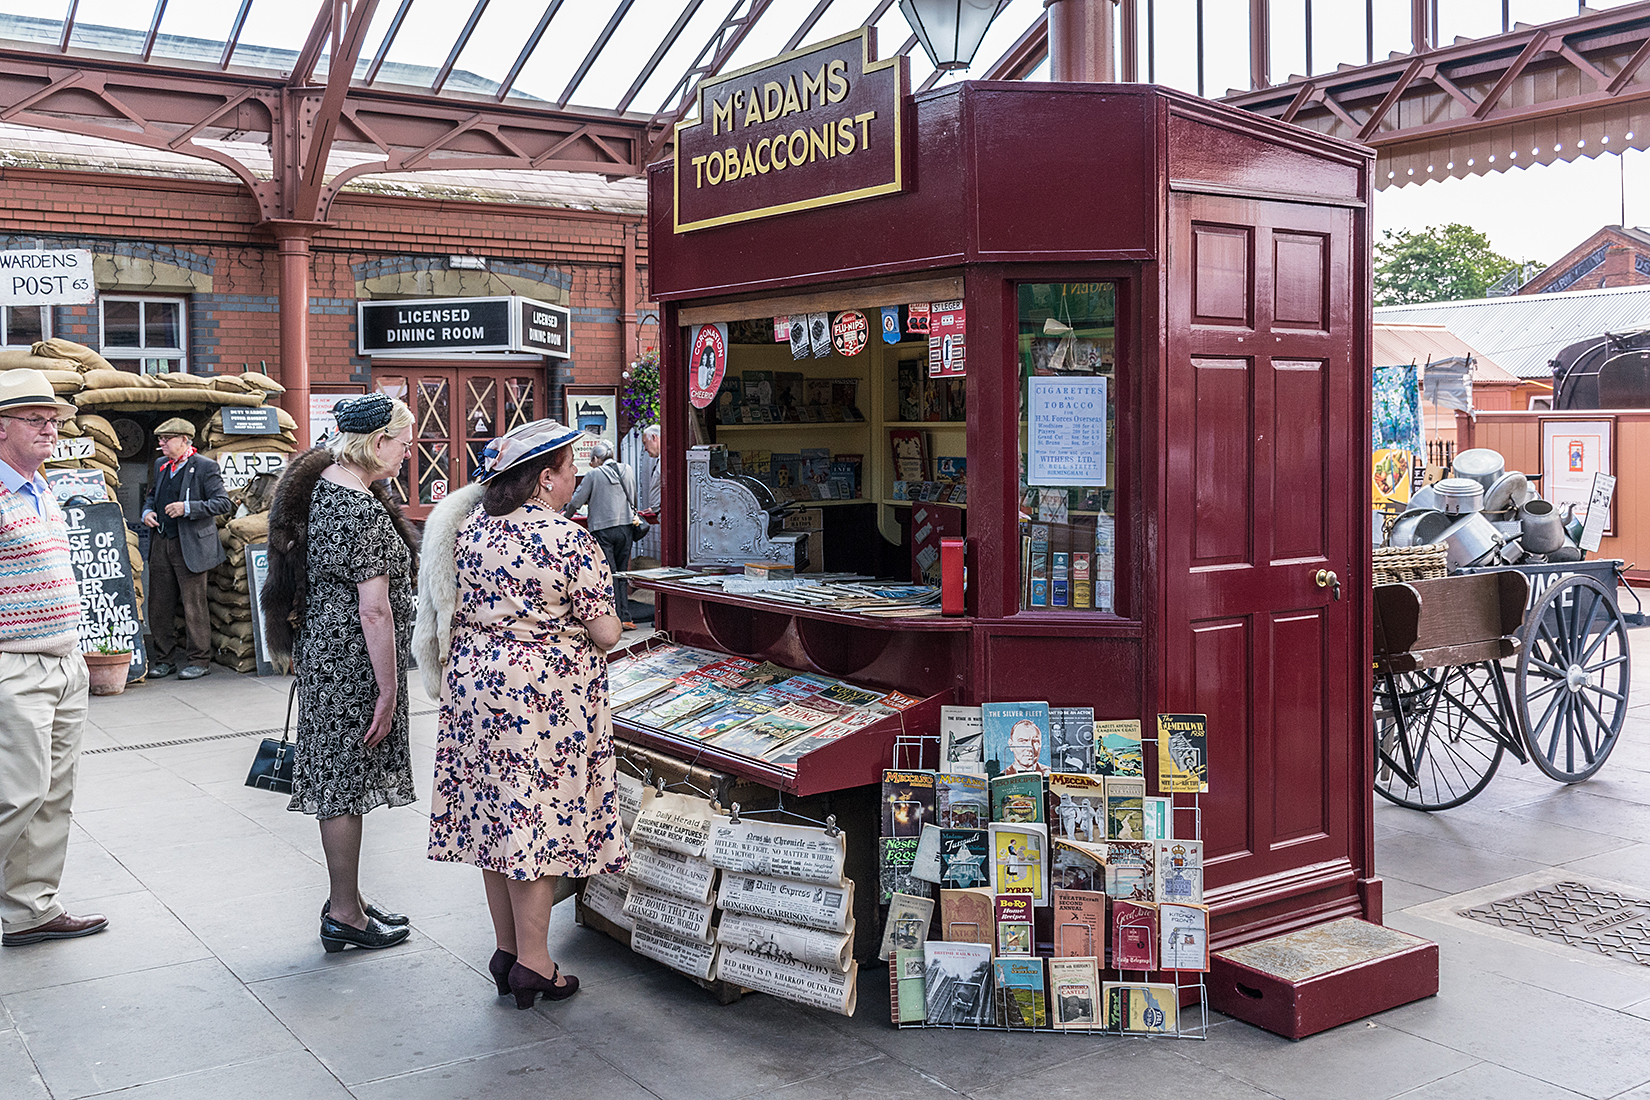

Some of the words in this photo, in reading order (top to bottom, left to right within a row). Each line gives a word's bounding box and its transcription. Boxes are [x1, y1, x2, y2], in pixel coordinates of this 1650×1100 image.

[692, 111, 875, 188] TOBACCONIST
[0, 254, 78, 268] WARDENS
[13, 276, 69, 295] POST
[72, 278, 89, 290] 63
[399, 309, 470, 324] LICENSED
[532, 311, 558, 329] LICENSED
[387, 328, 435, 342] DINING
[442, 326, 484, 340] ROOM
[835, 320, 864, 334] FLU-NIPS
[528, 328, 547, 344] DINING
[547, 330, 562, 346] ROOM
[694, 328, 724, 358] CORONATION
[1036, 387, 1103, 395] CIGARETTES
[95, 532, 115, 548] OF
[98, 549, 119, 563] GO
[77, 562, 123, 579] YOUR
[95, 605, 132, 623] TAKE
[112, 621, 139, 636] AND
[831, 685, 874, 701] COUNTRY
[889, 692, 914, 706] WAR
[779, 706, 821, 722] FLYING
[885, 772, 934, 784] MECCANO
[939, 775, 985, 787] MECCANO
[1008, 776, 1040, 785] RECIPES
[1051, 775, 1099, 787] MECCANO
[656, 811, 671, 821] Daily
[674, 815, 701, 827] Herald
[636, 824, 652, 834] TOWNS
[654, 827, 667, 838] NEAR
[667, 830, 683, 843] REICH
[638, 818, 659, 828] AIRBORNE
[659, 821, 673, 831] ARMY
[674, 827, 703, 839] CAPTURES
[746, 832, 762, 842] News
[773, 836, 806, 848] Chronicle
[886, 840, 918, 849] Nests
[714, 839, 739, 849] HITLER:
[783, 849, 809, 859] MATTER
[715, 847, 729, 855] TILL
[731, 850, 756, 859] VICTORY
[886, 850, 917, 865] Eggs
[634, 851, 658, 865] GERMAN
[657, 860, 675, 872] FRONT
[676, 866, 708, 882] COLLAPSES
[755, 880, 776, 894] Daily
[779, 885, 811, 897] Express
[630, 895, 644, 905] THE
[645, 899, 666, 912] BOMB
[668, 904, 687, 917] THAT
[688, 911, 704, 923] HAS
[722, 900, 765, 914] HONGKONG
[767, 906, 809, 921] GARRISON
[1000, 899, 1026, 908] Be-Ro
[628, 904, 658, 920] CHANGED
[661, 914, 675, 924] THE
[677, 919, 699, 932] WORLD
[1117, 908, 1135, 928] Good
[800, 962, 828, 975] NEWS
[724, 958, 736, 967] RED
[738, 962, 755, 973] ARMY
[774, 973, 804, 985] KHARKOV
[807, 980, 844, 996] OUTSKIRTS
